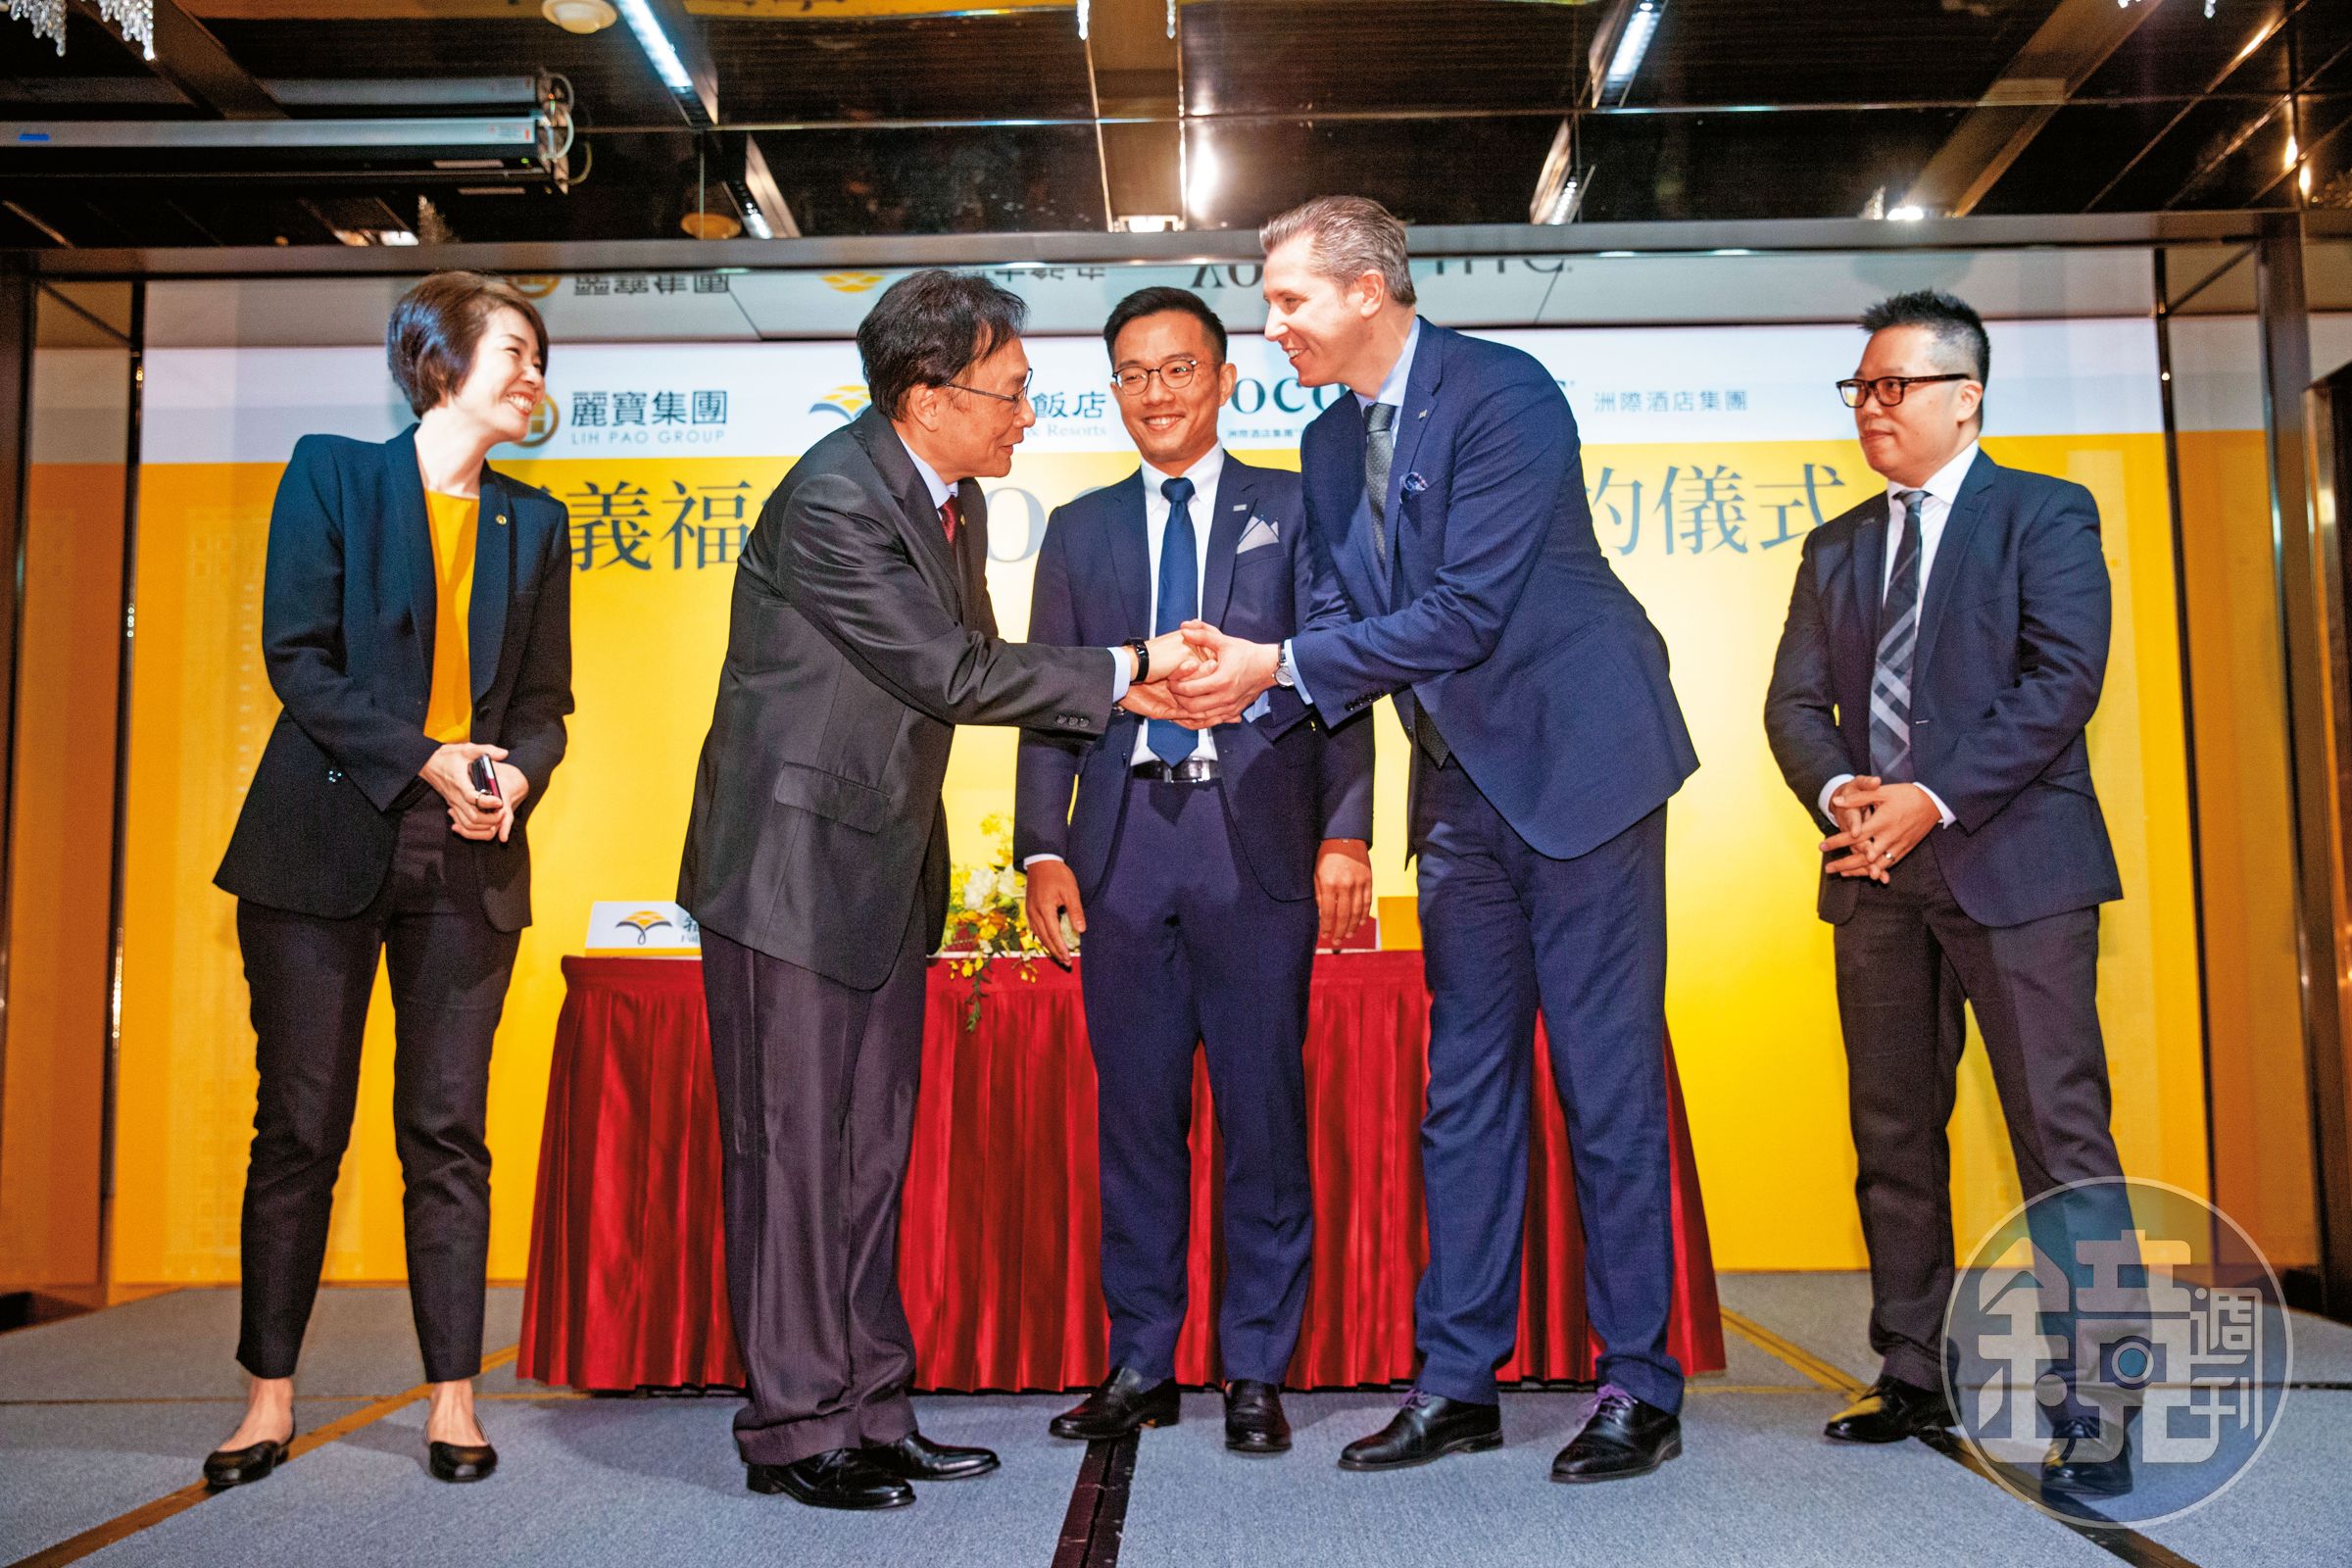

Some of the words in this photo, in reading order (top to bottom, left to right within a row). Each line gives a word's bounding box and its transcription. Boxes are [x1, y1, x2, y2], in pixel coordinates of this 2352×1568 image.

[570, 390, 727, 427] 麗寶集團
[1031, 391, 1106, 418] 飯店
[1231, 377, 1348, 414] oco
[1593, 390, 1747, 412] 洲際酒店集團
[571, 432, 600, 445] LIH
[610, 431, 649, 444] PAO
[657, 429, 724, 443] GROUP
[534, 479, 774, 571] 義福
